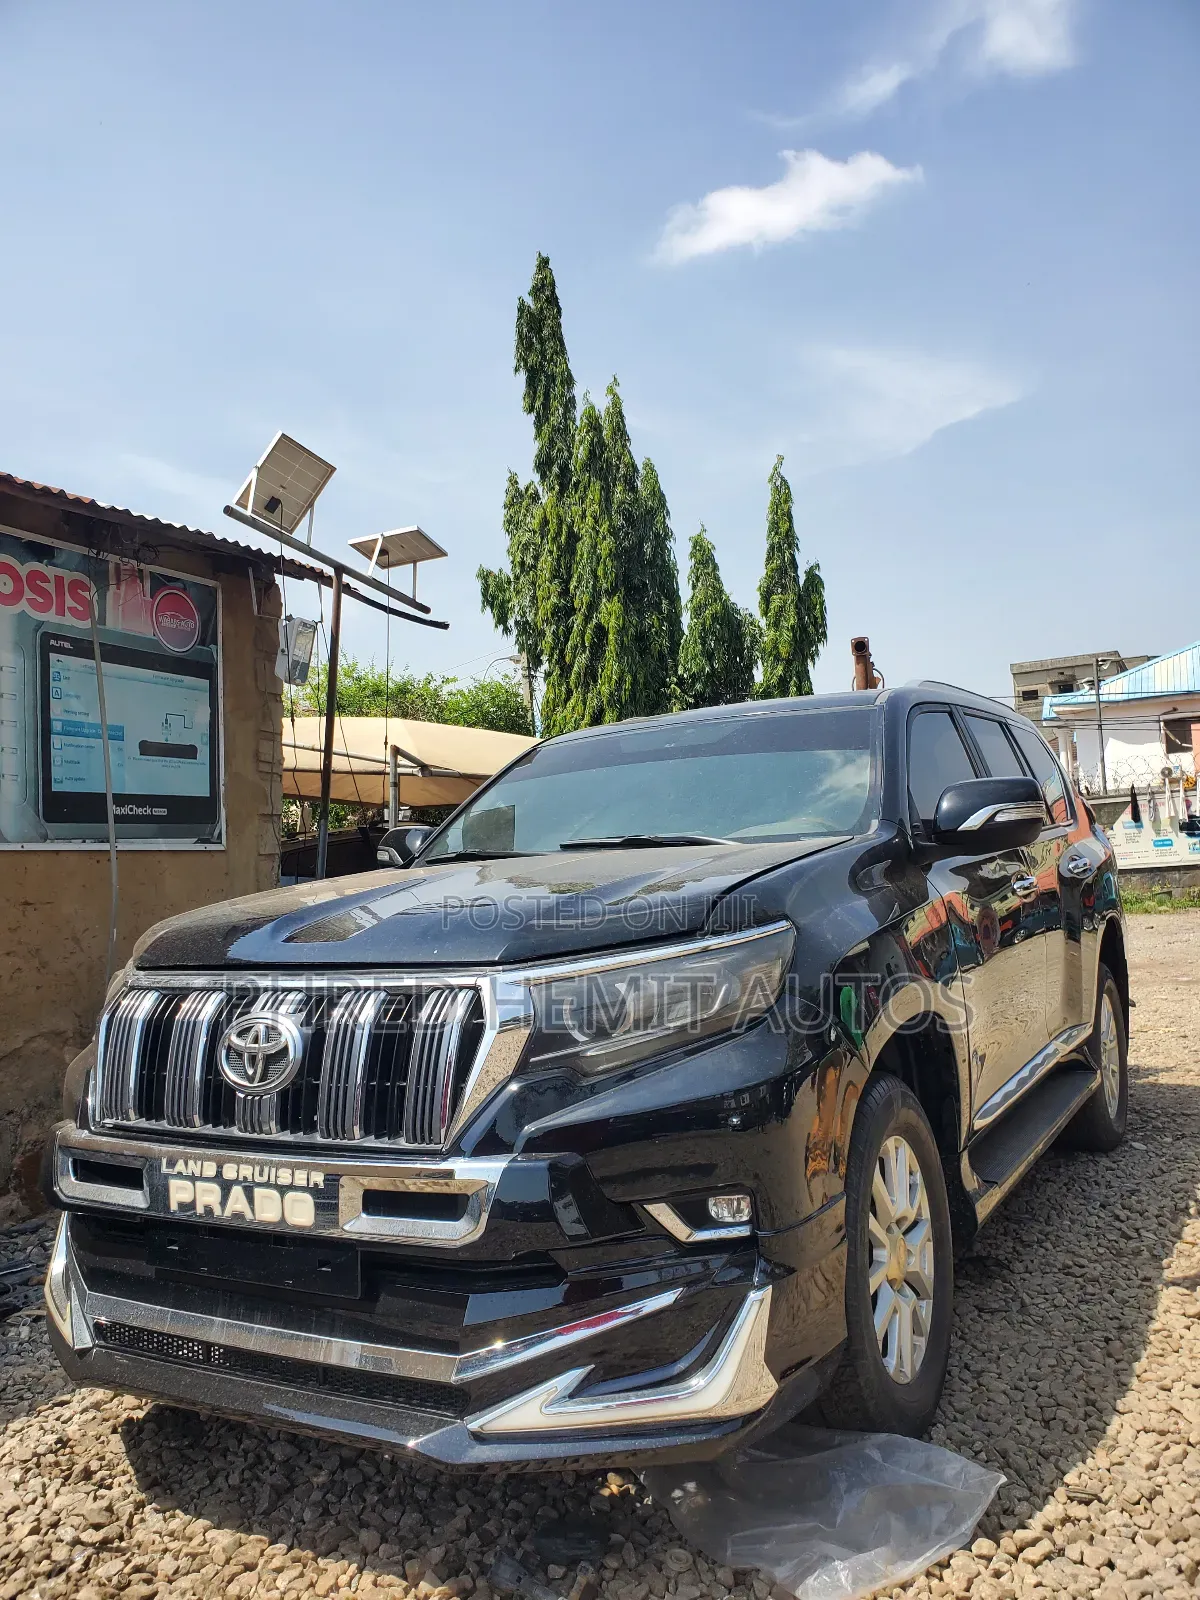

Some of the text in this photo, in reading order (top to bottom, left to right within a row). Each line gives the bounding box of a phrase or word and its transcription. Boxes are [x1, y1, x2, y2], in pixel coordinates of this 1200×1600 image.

[49, 639, 74, 649] AUTEL
[161, 1157, 325, 1188] LAND CRUISER
[168, 1179, 315, 1228] PRADO
